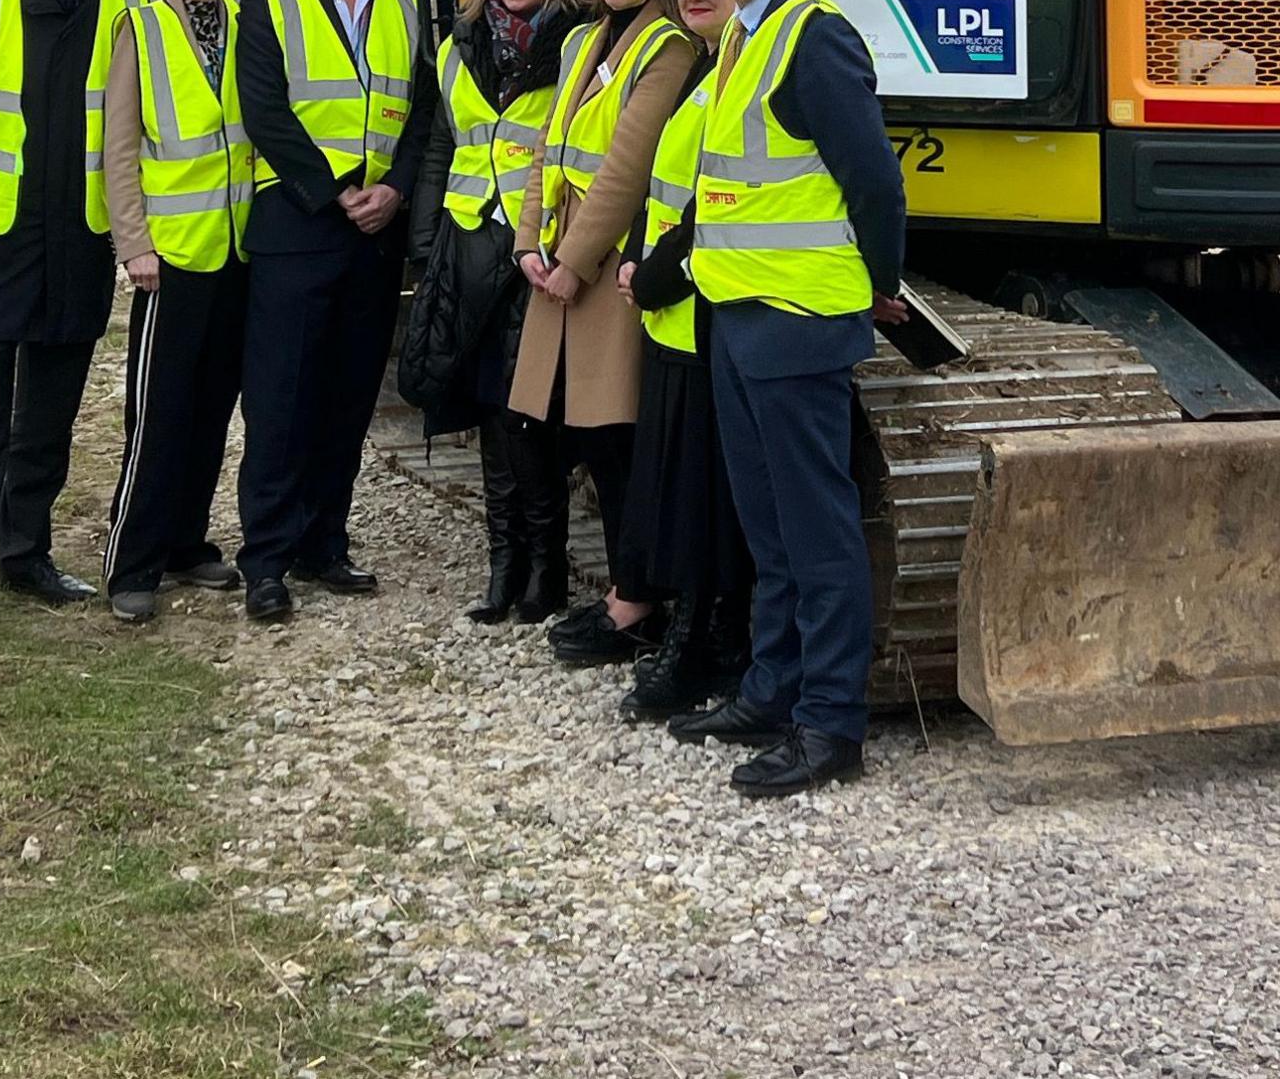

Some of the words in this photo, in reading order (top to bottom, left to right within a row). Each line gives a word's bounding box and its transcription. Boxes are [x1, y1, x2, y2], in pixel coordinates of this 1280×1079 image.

[937, 8, 1004, 37] LPL
[938, 37, 1004, 46] CONSTRUCTION
[966, 45, 1004, 54] SERVICES
[705, 191, 737, 205] CARTER
